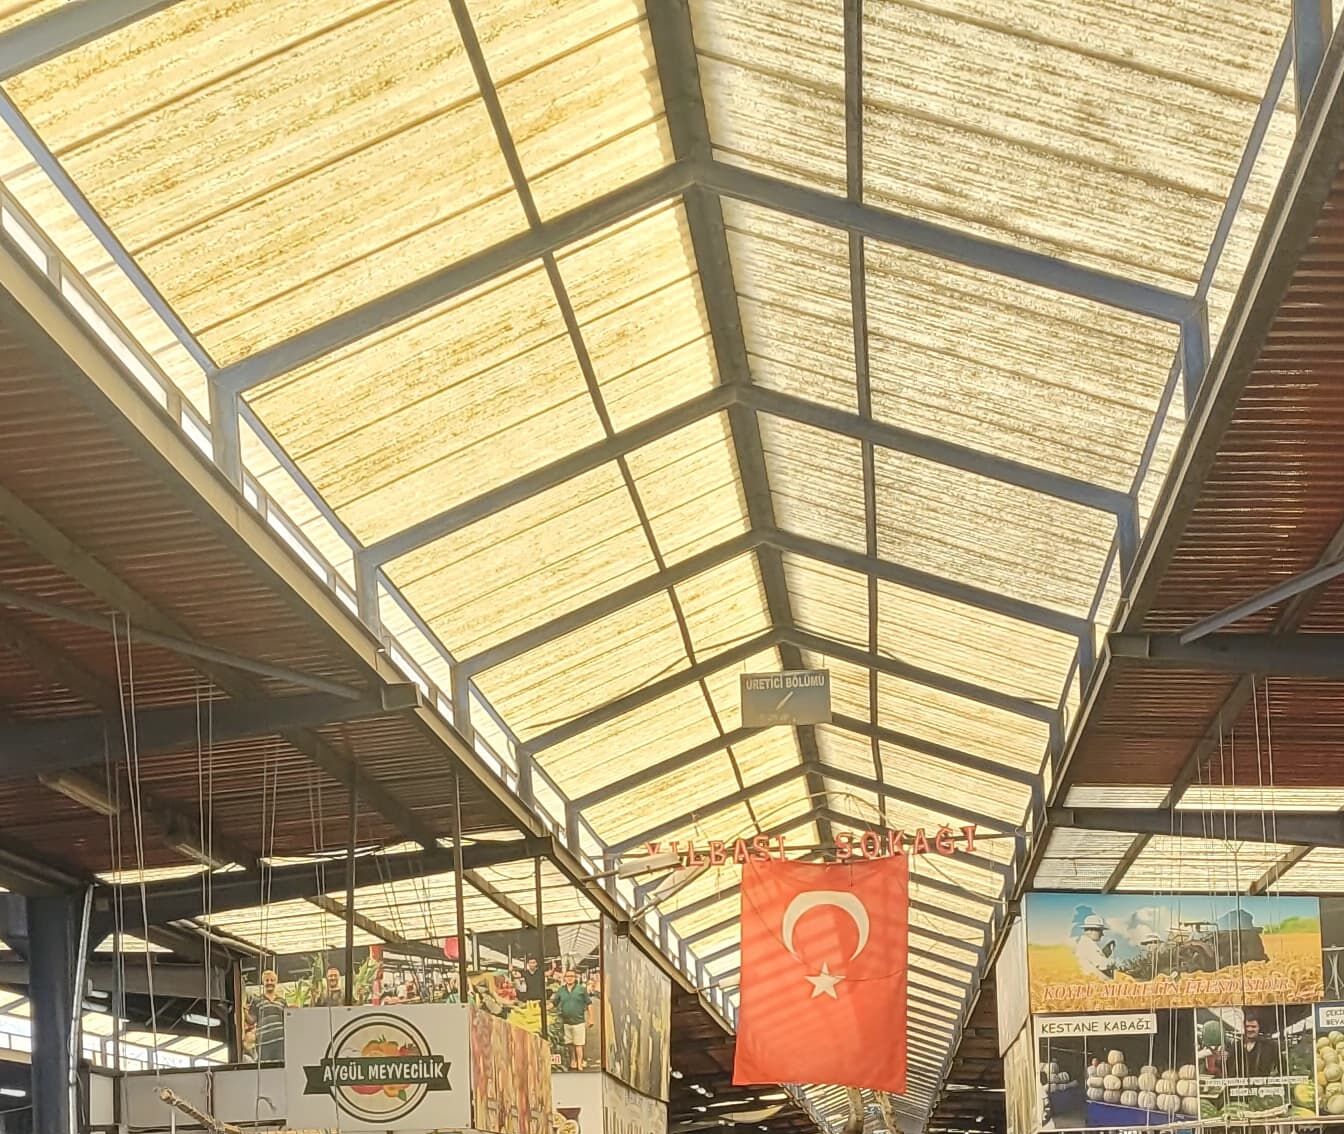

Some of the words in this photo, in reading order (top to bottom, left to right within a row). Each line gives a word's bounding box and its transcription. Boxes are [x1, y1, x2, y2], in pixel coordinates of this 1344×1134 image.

[834, 823, 976, 859] SOKAĞI
[1041, 1021, 1099, 1034] KESTANE
[1104, 1017, 1152, 1031] KABAĞI
[323, 1062, 364, 1082] AYGÜL
[368, 1059, 443, 1080] MEYVECİLİK
